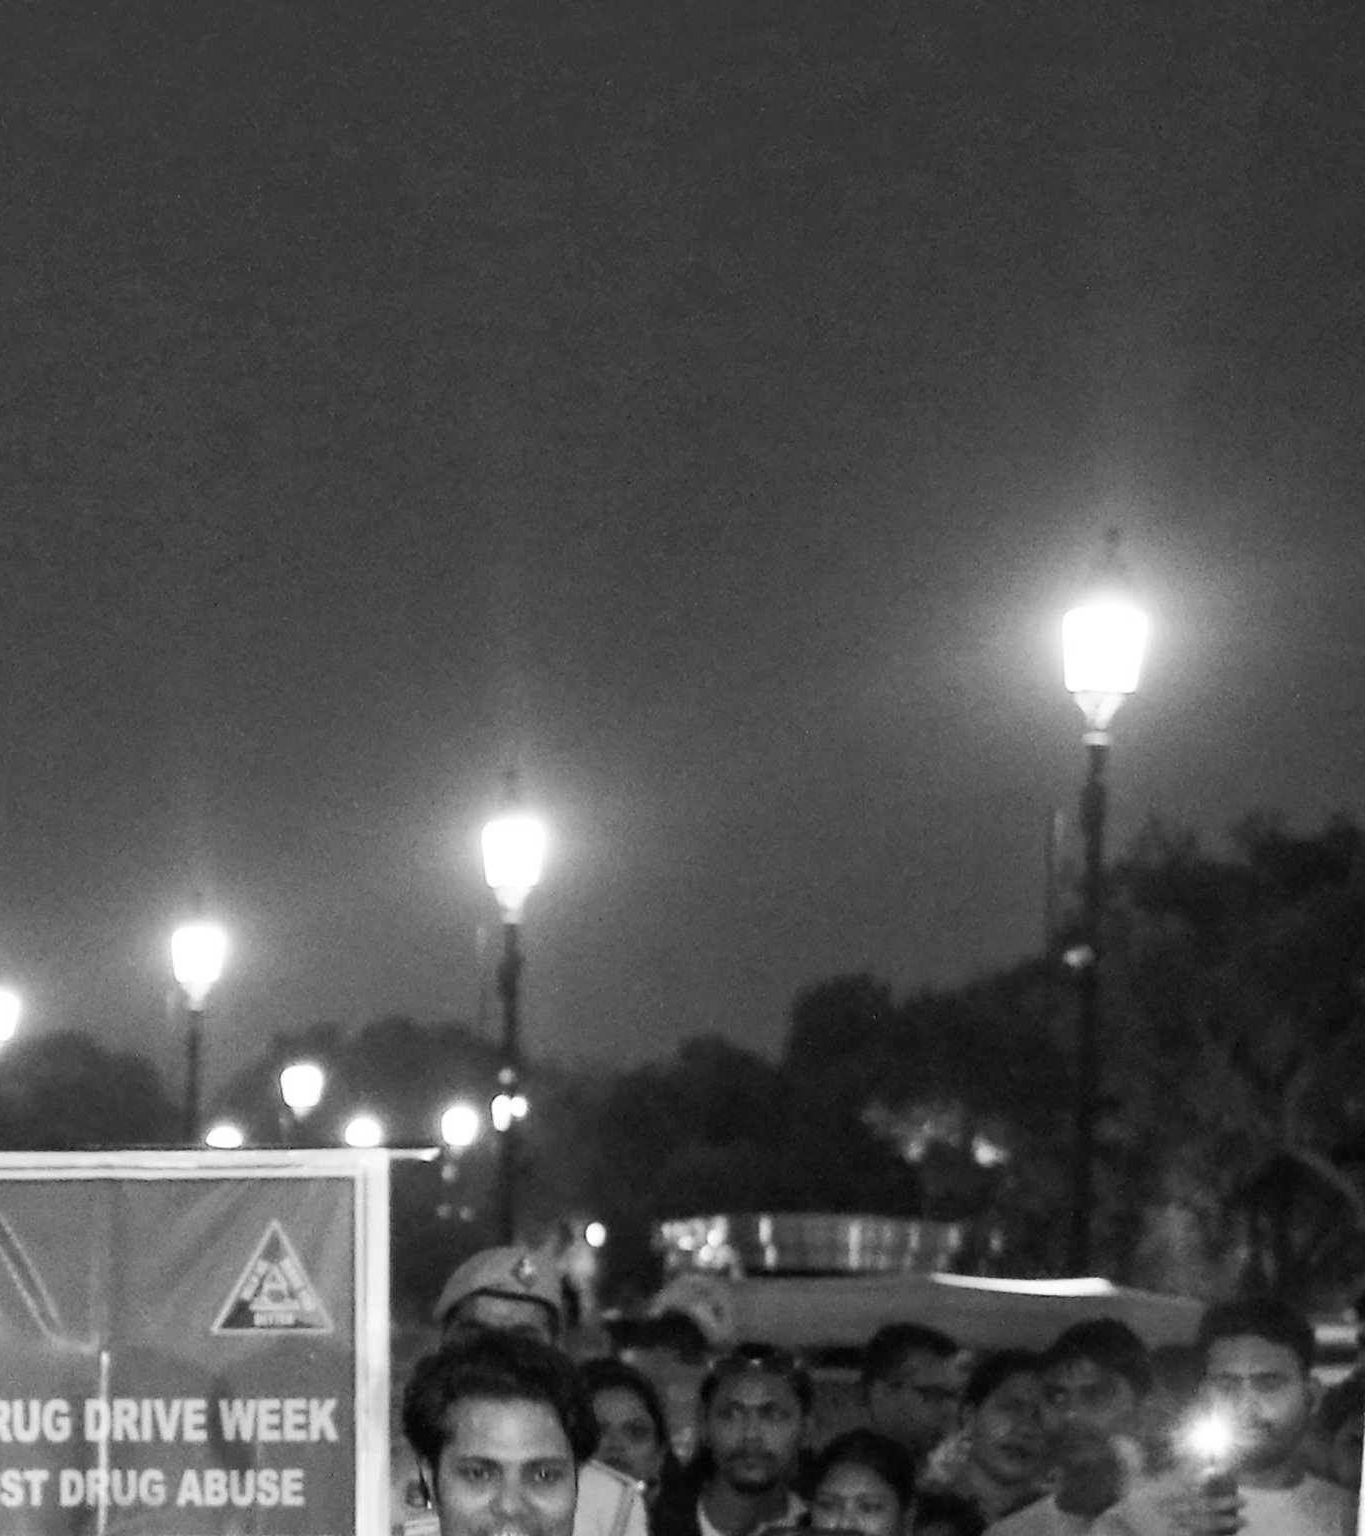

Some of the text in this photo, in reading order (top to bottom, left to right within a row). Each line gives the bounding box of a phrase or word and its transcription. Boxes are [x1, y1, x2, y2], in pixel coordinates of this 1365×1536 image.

[84, 1398, 208, 1442] DRIVE
[218, 1398, 340, 1442] WEEK
[58, 1469, 168, 1508] DRUG
[176, 1469, 306, 1508] ABUSE
